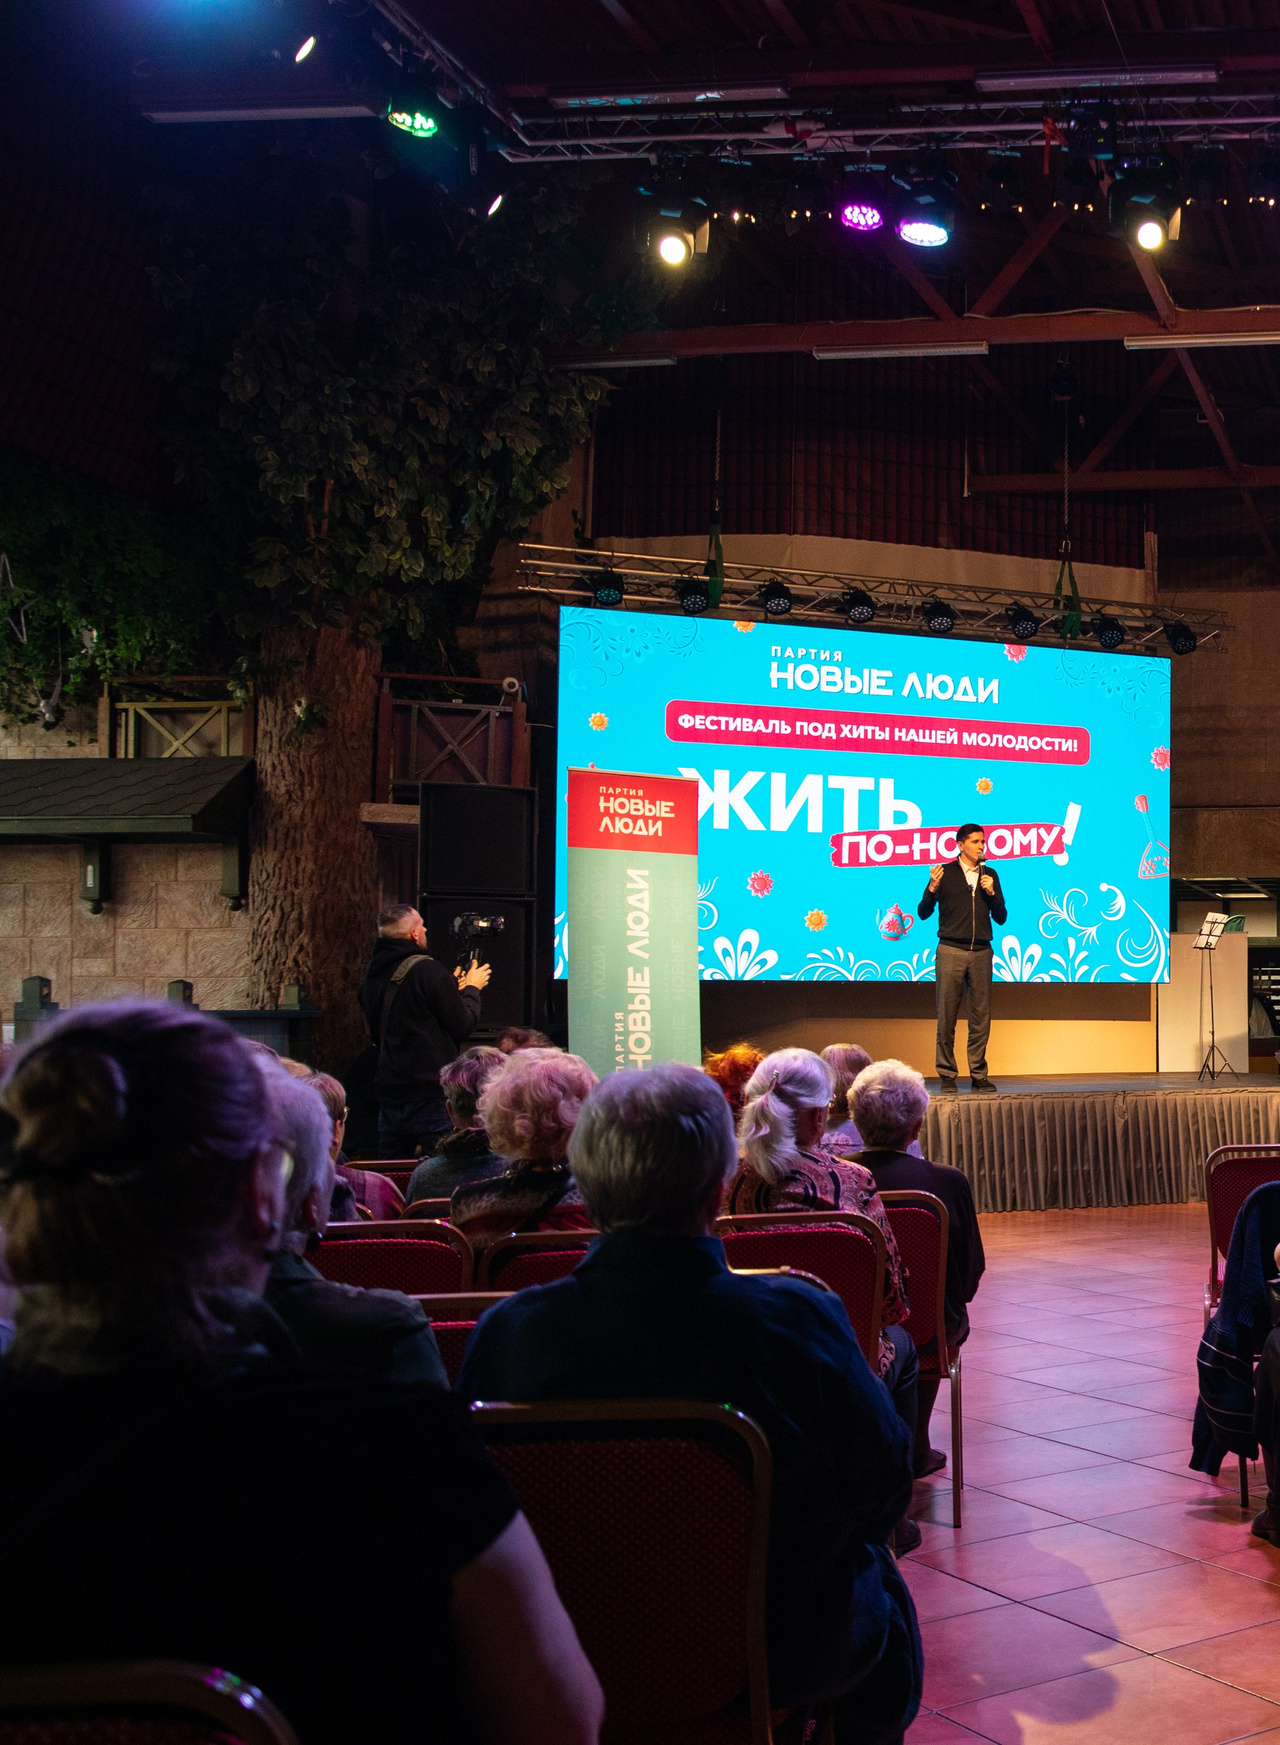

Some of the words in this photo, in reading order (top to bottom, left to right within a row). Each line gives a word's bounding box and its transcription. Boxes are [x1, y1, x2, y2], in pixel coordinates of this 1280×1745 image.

[771, 645, 843, 662] ПАРТИЯ
[770, 661, 893, 696] НОВЫЕ
[902, 671, 999, 704] ЛЮДИ
[677, 714, 791, 735] ФЕСТИВАЛЬ
[796, 721, 836, 739] ПОД
[840, 724, 890, 741] ХИТЫ
[894, 727, 959, 745] НАШЕЙ
[962, 731, 1078, 753] МОЛОДОСТИ!
[599, 786, 644, 797] ПАРТИЯ
[599, 796, 675, 818] НОВЫЕ
[677, 767, 922, 833] ЖИТЬ
[599, 816, 663, 836] ЛЮДИ
[841, 801, 1082, 866] ПО-НООМУ!
[626, 868, 650, 959] ЛЮДИ
